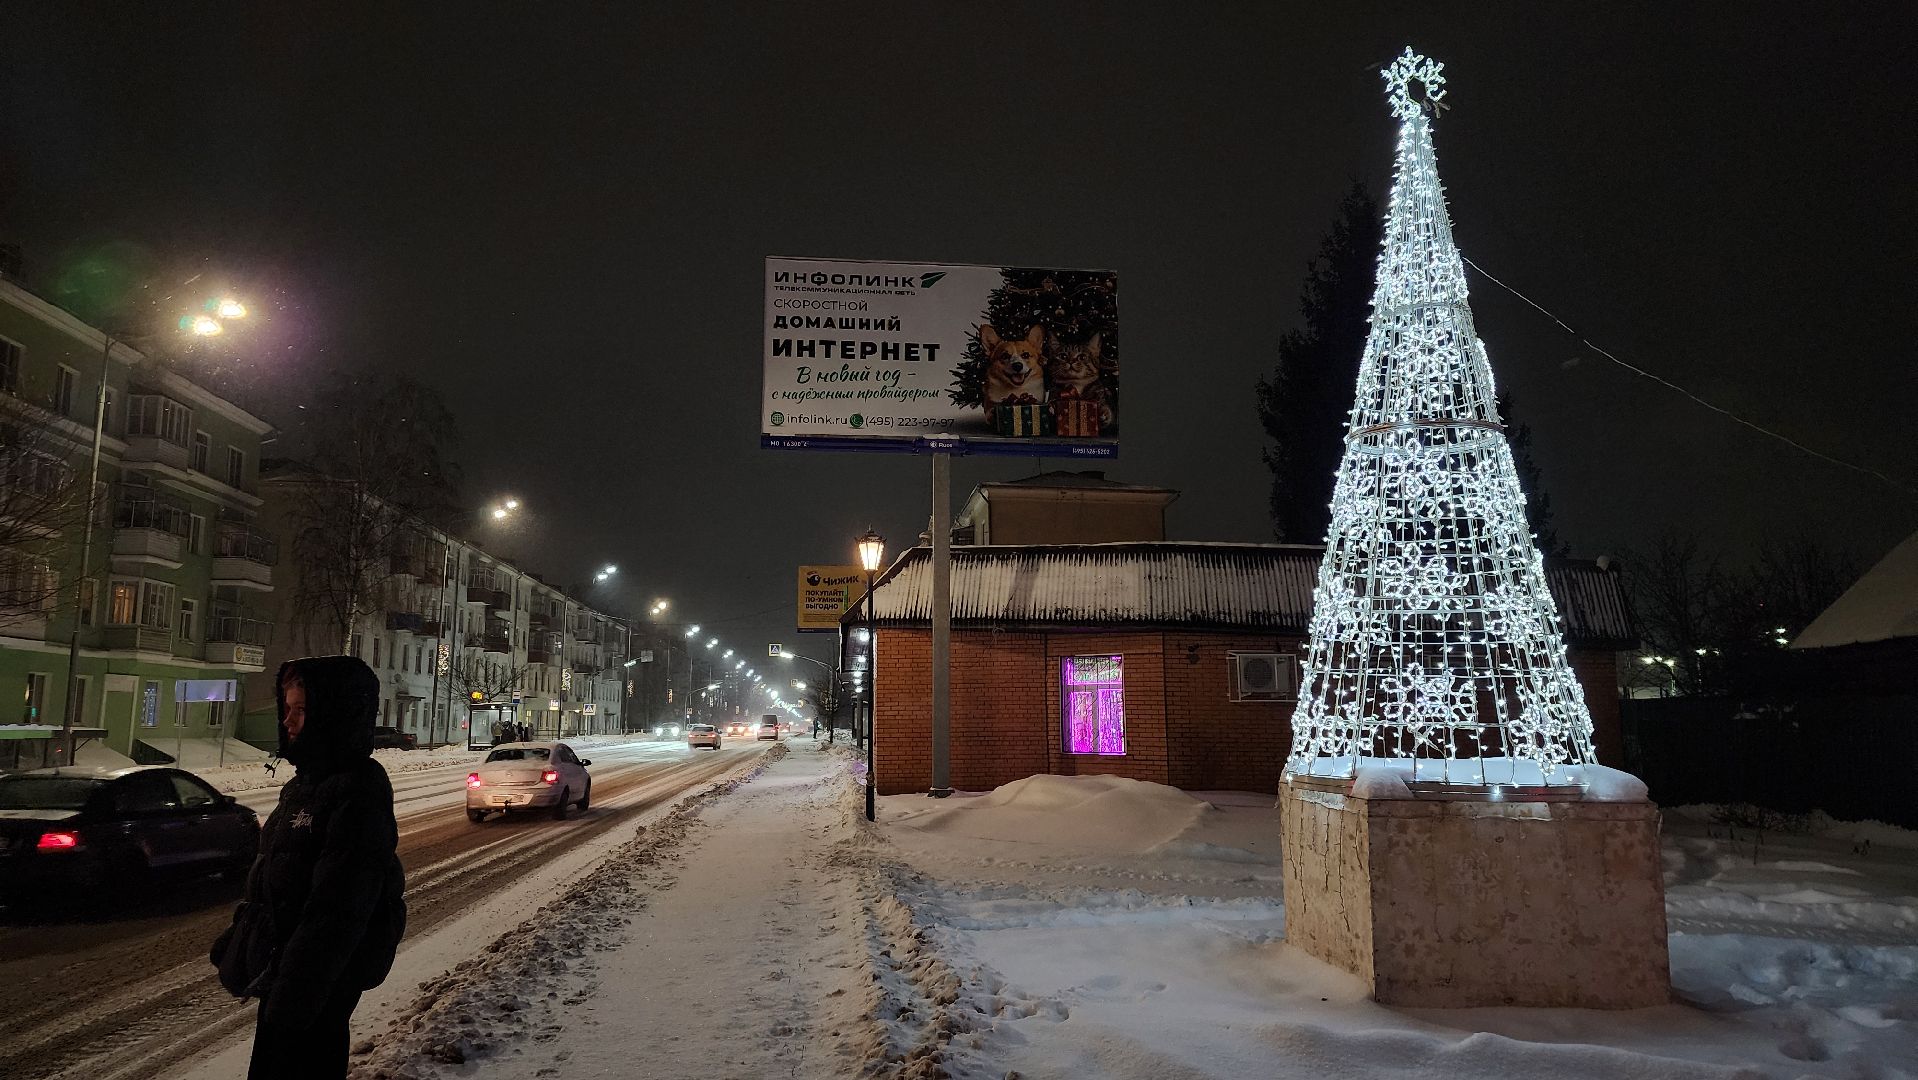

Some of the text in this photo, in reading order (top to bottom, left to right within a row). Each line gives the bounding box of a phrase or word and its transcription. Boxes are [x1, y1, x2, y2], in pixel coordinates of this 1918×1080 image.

[774, 271, 915, 288] ИНФОЛИНК
[773, 295, 868, 312] СКОРОСТНОЙ
[773, 315, 901, 332] ДОМАШНИЙ
[772, 339, 941, 362] ИНТЕРНЕТ
[796, 366, 811, 384] В
[816, 363, 870, 383] новый
[875, 368, 901, 387] год
[771, 385, 939, 404] с надёжным провайдером
[787, 413, 955, 429] infolink.ru (495) 223-97-97
[805, 603, 839, 611] ВЫГОДНО
